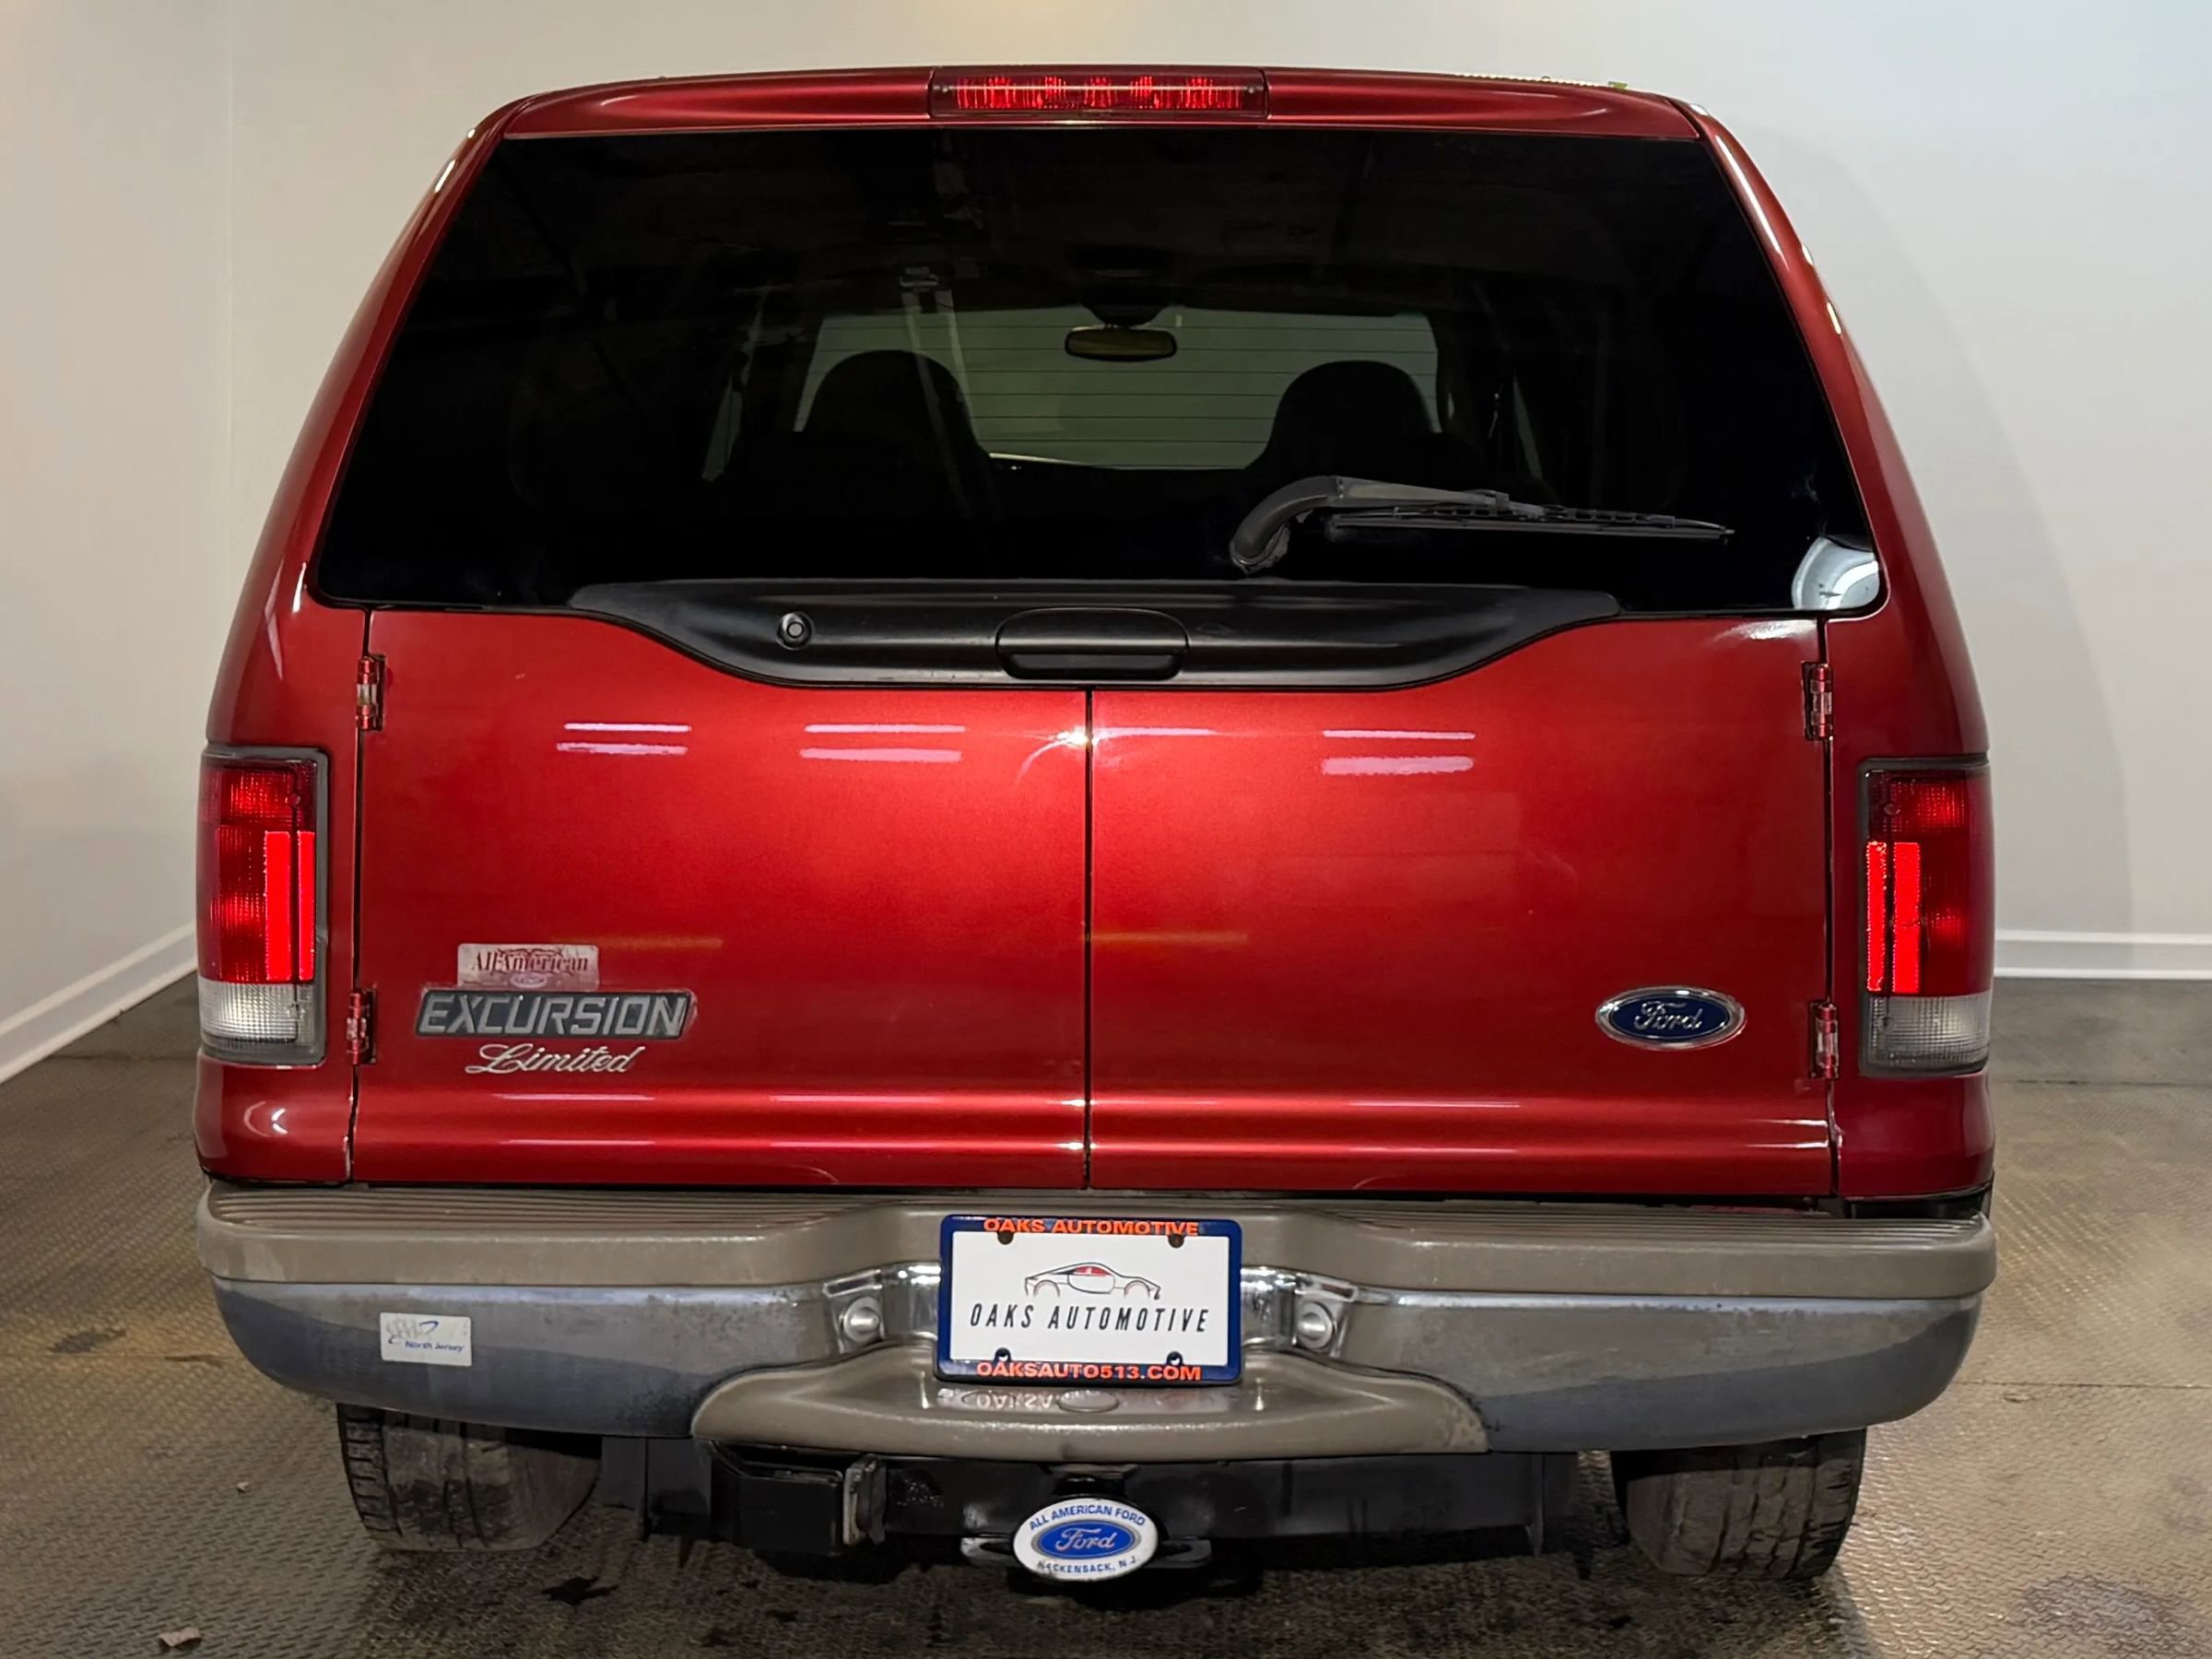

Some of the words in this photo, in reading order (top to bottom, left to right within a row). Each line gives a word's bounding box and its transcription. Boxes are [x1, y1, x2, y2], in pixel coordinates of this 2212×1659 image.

[418, 995, 689, 1036] EXCURSION
[1634, 1001, 1702, 1030] Ford
[465, 1043, 645, 1074] Limited
[983, 1218, 1045, 1233] OAKS
[1054, 1219, 1199, 1236] AUTOMOTIVE
[971, 1303, 1034, 1328] OAKS
[1048, 1306, 1209, 1333] AUTOMOTIVE
[405, 1340, 433, 1349] North
[434, 1342, 465, 1353] Jersey
[976, 1361, 1202, 1381] OAKSAUTO513.COM
[1030, 1514, 1049, 1531] ALL
[1052, 1504, 1113, 1520] AMERICAN
[1114, 1508, 1146, 1526] FORD
[1055, 1527, 1118, 1551] Ford
